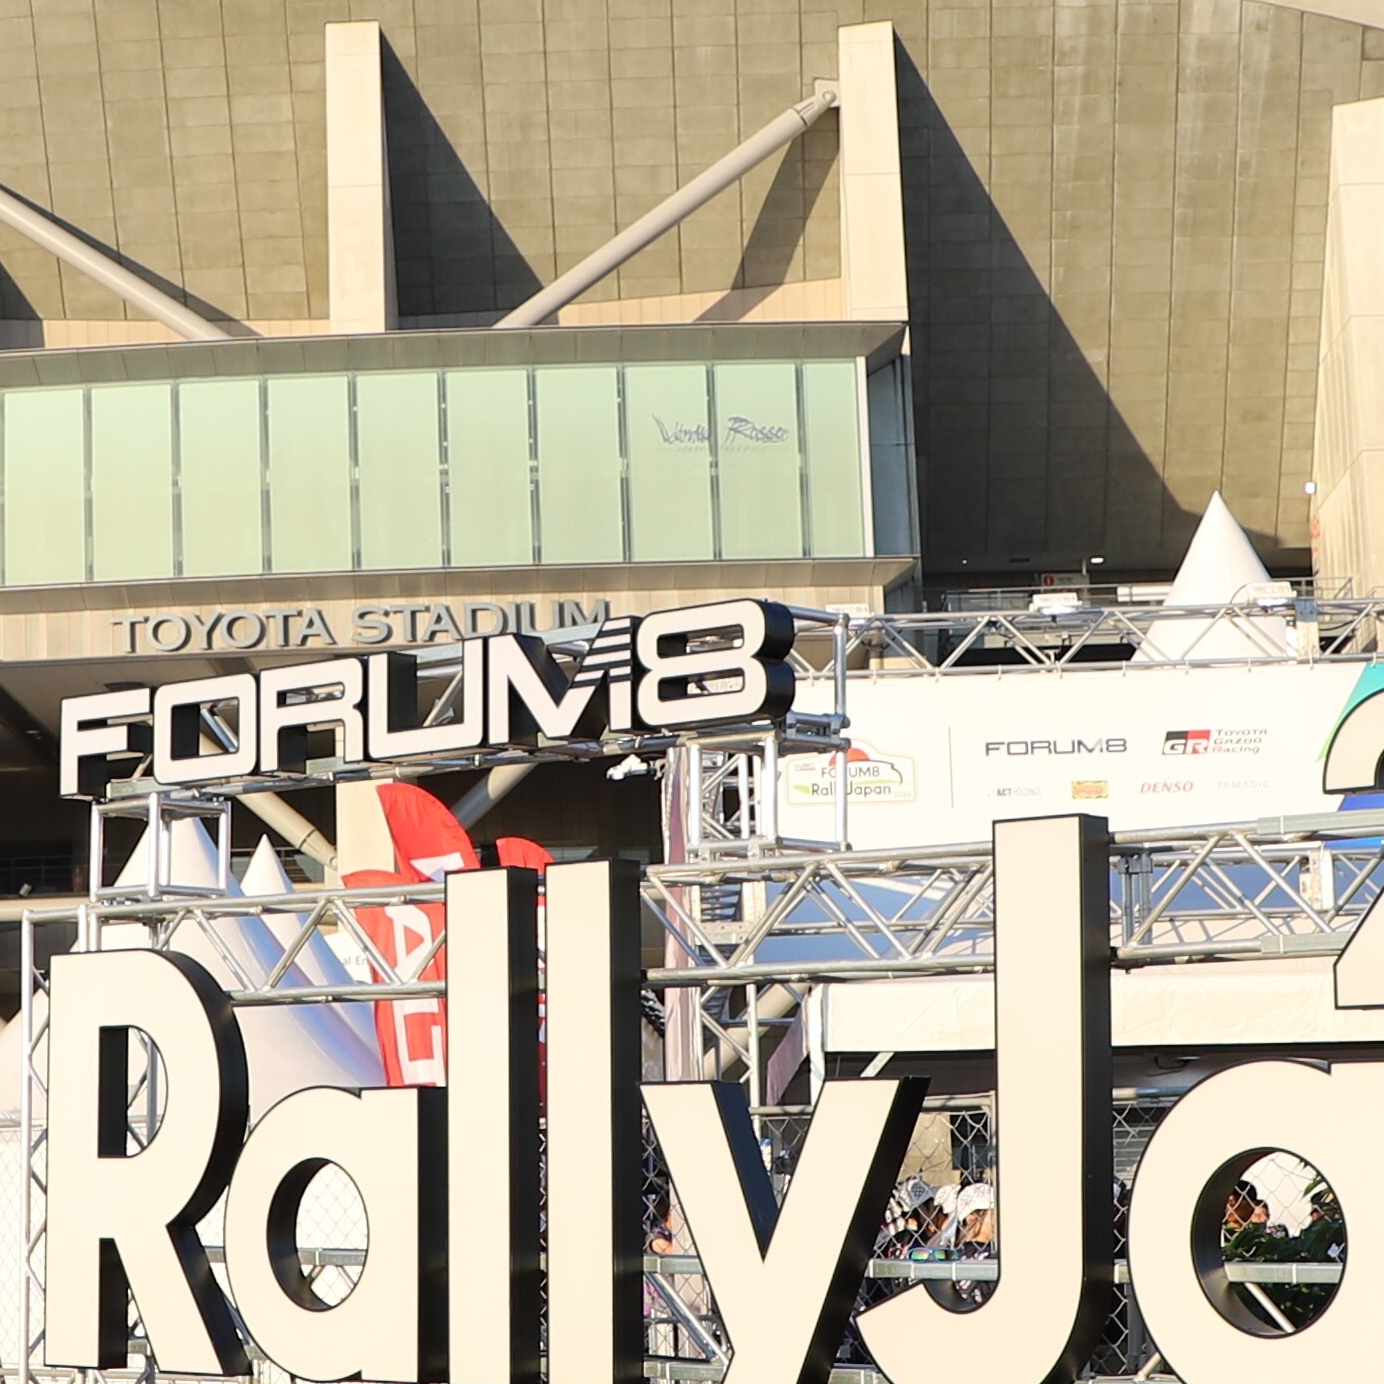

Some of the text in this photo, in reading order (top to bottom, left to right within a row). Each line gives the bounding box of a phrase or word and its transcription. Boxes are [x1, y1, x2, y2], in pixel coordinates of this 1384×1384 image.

[111, 600, 612, 653] TOYOTA STADIUM
[59, 598, 796, 799] FORUM8
[985, 738, 1127, 756] FORUM8
[1162, 737, 1210, 755] GR
[1213, 737, 1263, 745] GAZOO
[1211, 745, 1261, 754] Racing
[821, 766, 881, 779] FOUM8
[846, 780, 891, 798] Japan
[1140, 781, 1194, 794] DENSO
[1216, 780, 1271, 790] TAMADIC
